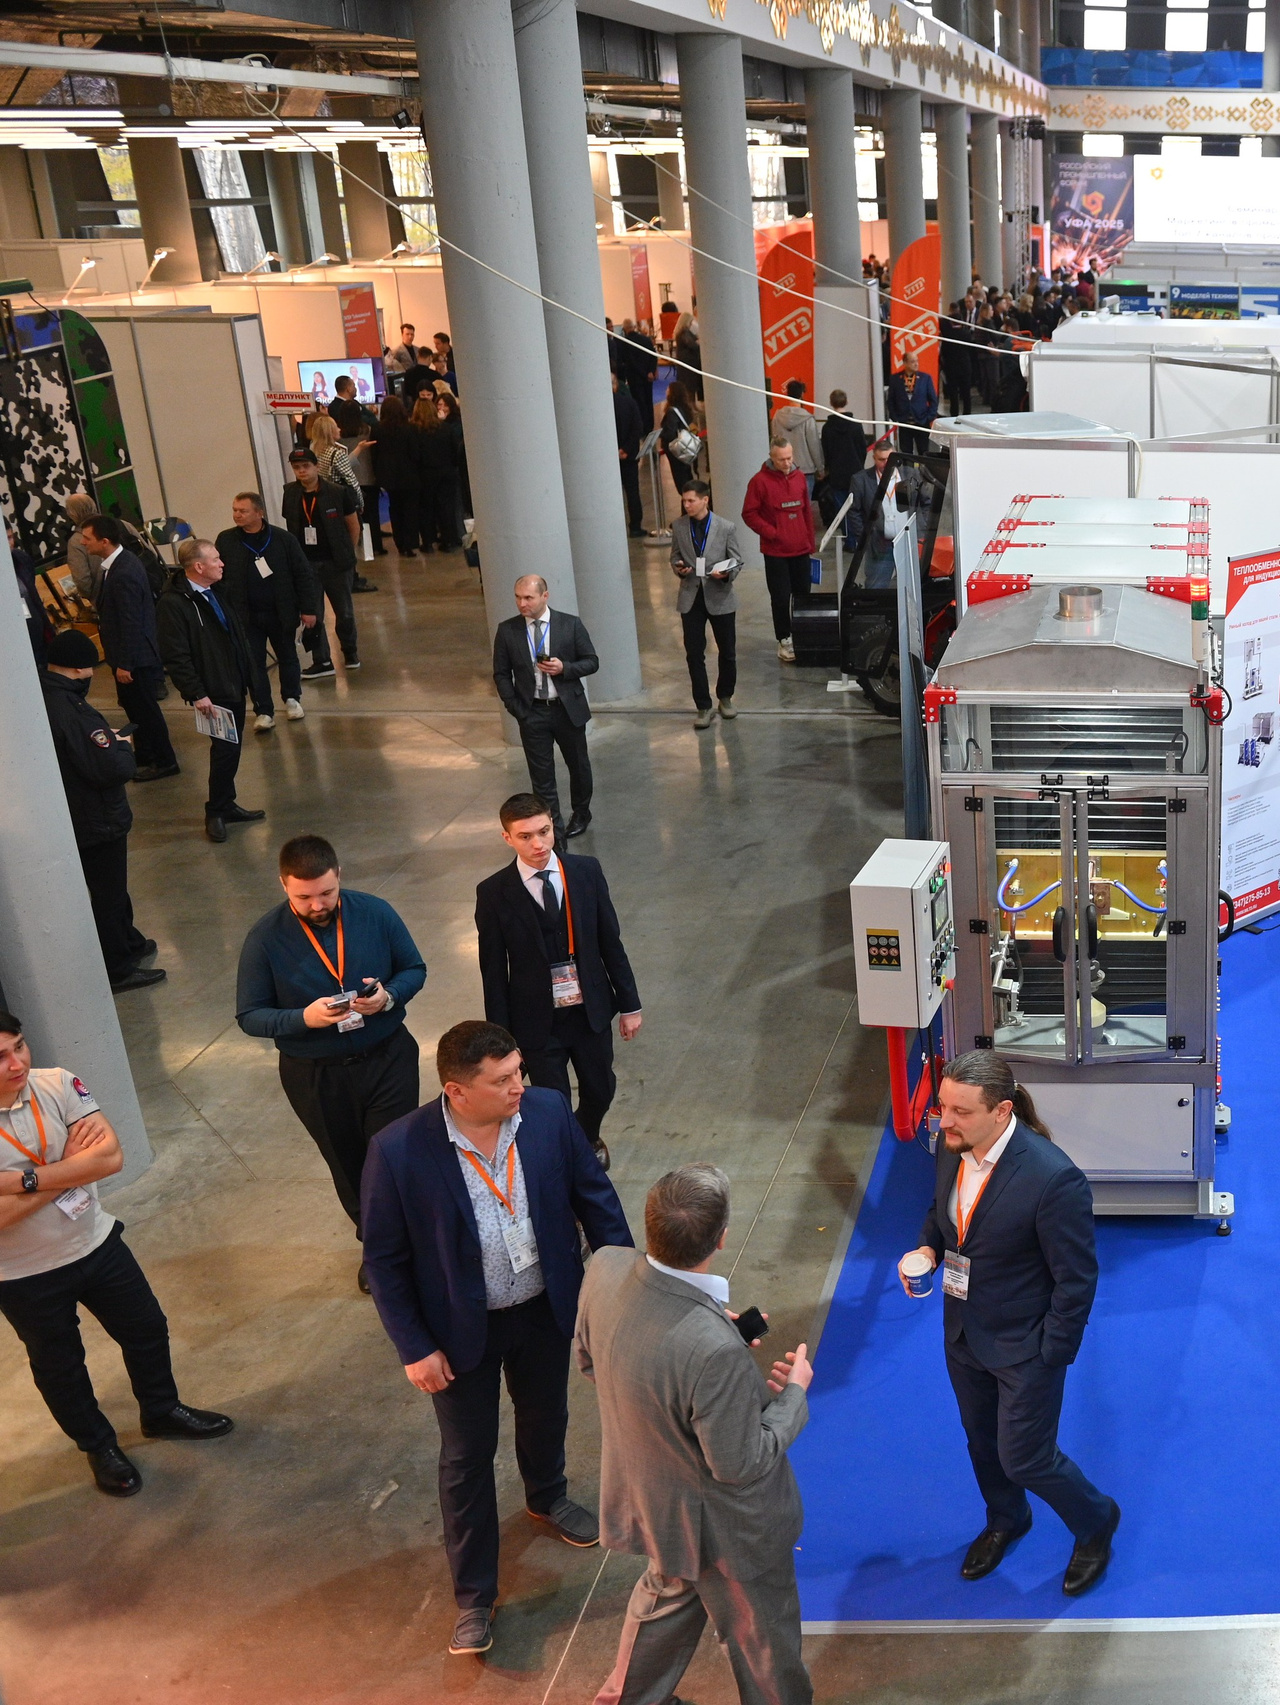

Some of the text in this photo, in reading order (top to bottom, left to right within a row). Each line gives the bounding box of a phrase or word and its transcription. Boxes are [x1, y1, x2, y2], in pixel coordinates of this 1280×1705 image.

[1064, 218, 1124, 230] УФА 2025
[1172, 287, 1181, 299] 9
[765, 315, 811, 352] УТТЗ
[895, 320, 937, 355] УТТЗ
[1243, 575, 1255, 585] для
[1233, 886, 1271, 909] 347)275-85-13
